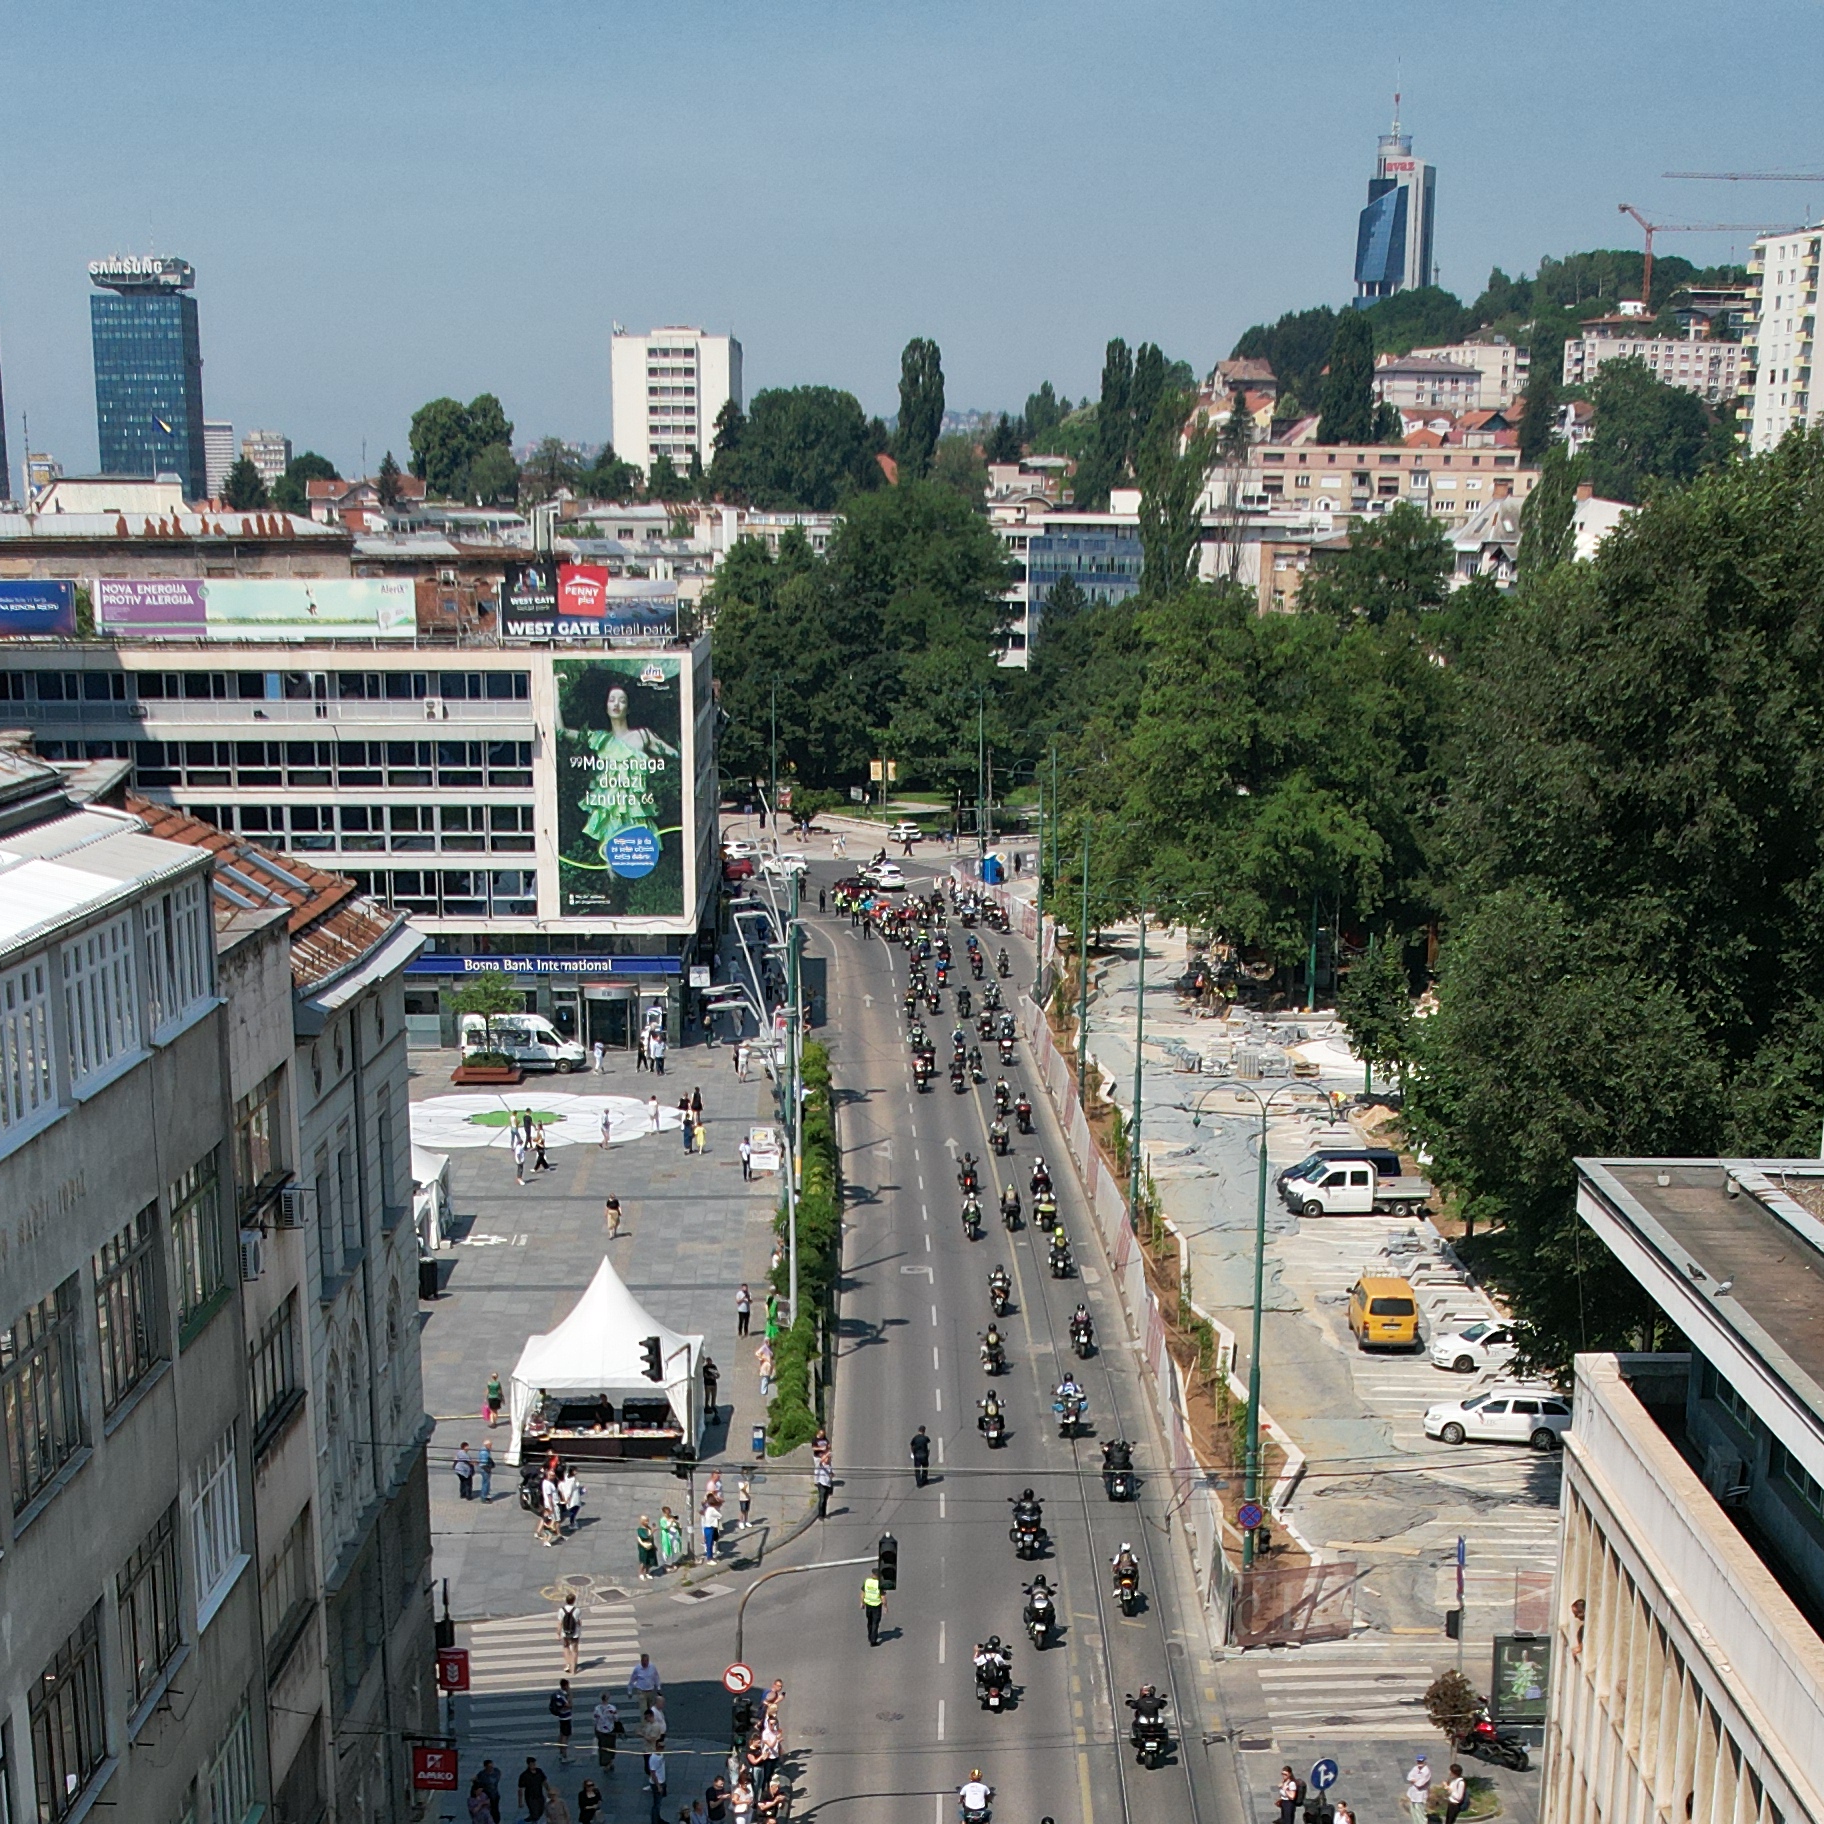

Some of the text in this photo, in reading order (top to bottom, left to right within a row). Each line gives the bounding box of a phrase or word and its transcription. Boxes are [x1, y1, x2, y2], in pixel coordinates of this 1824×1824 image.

[88, 261, 163, 274] SAMSUNG
[101, 583, 133, 594] NOVA
[565, 586, 599, 597] PENNY
[102, 595, 142, 606] PROTIV
[509, 597, 555, 606] WEST GATE
[507, 621, 672, 638] WEST GATE Retail park
[624, 757, 665, 773] snaga
[599, 774, 646, 788] dolazi
[463, 959, 613, 971] Bosna Bank International
[416, 1771, 455, 1781] AMKO
